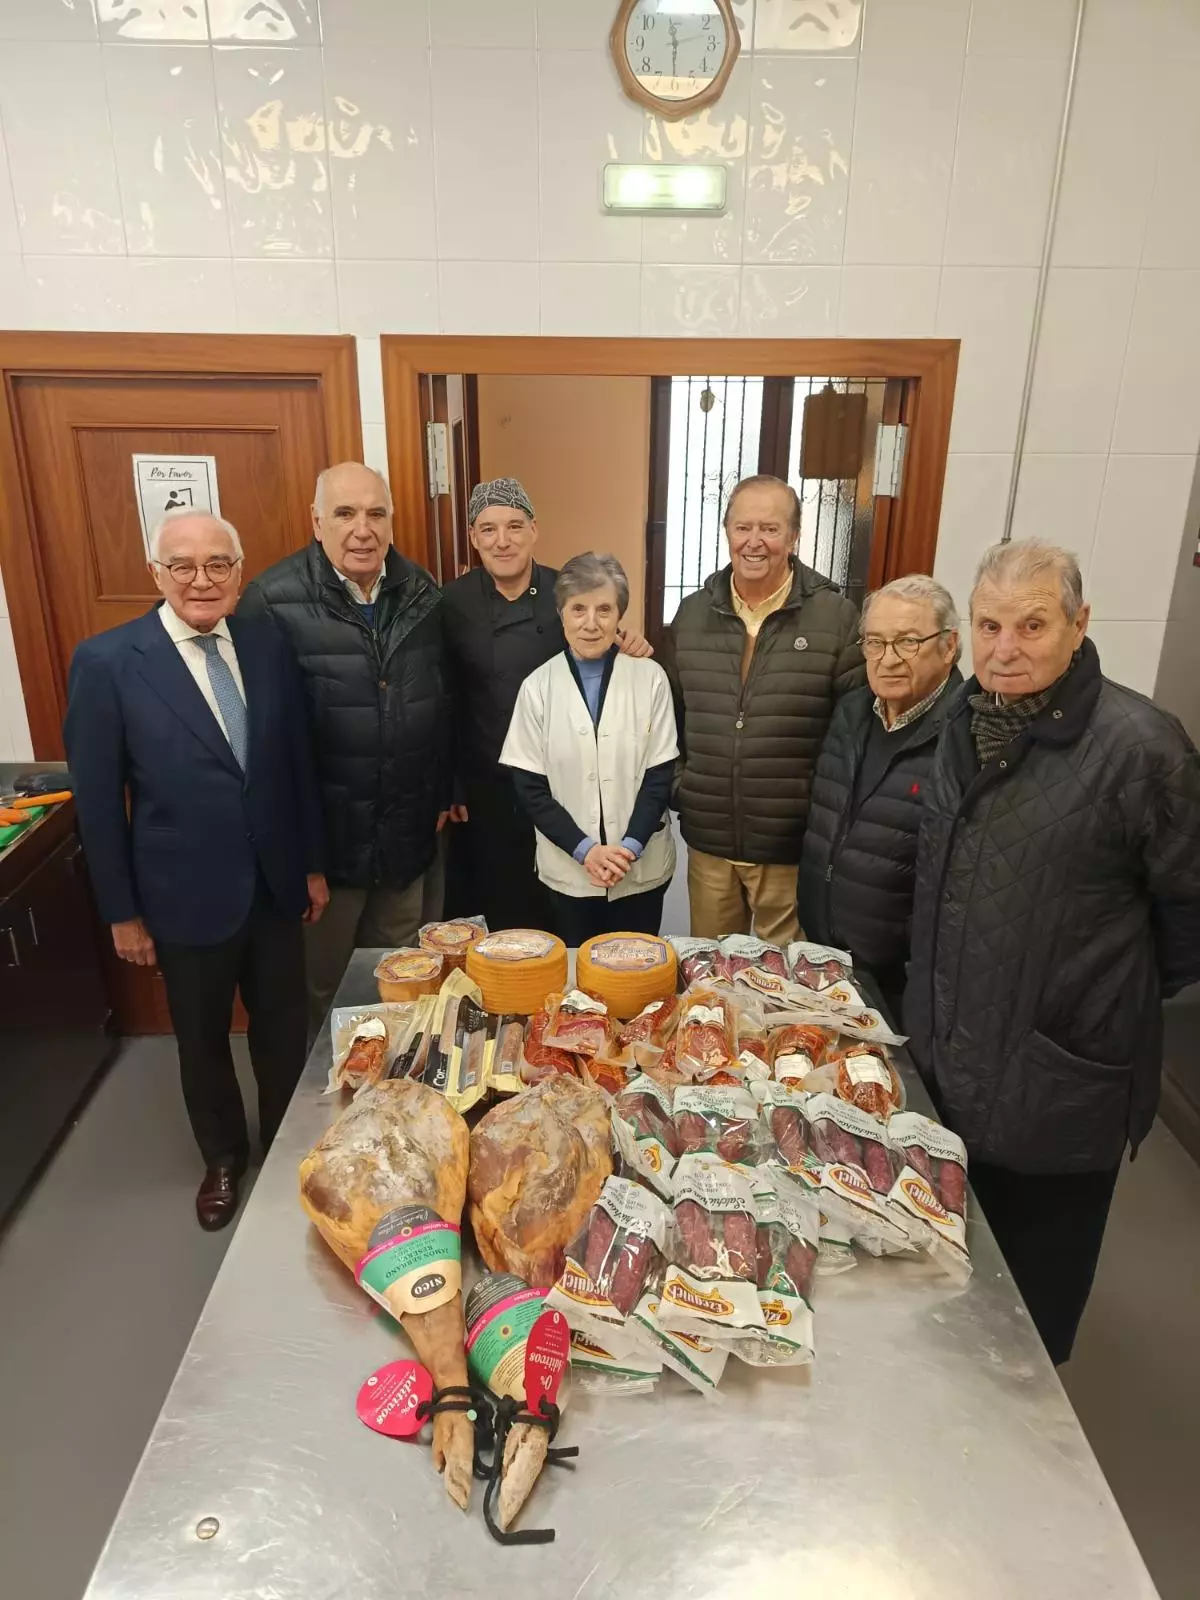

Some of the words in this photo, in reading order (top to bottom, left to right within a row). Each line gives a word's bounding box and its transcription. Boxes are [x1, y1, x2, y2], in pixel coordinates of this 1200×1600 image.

[643, 14, 655, 31] 10
[702, 14, 710, 30] 2
[636, 35, 645, 51] 9
[707, 35, 717, 51] 3
[642, 56, 651, 72] 8
[699, 57, 707, 72] 4
[150, 466, 166, 478] Por
[168, 467, 193, 479] Favor
[397, 1245, 433, 1262] RESERVA
[385, 1255, 422, 1278] SERRANO
[414, 1276, 443, 1296] NICO
[667, 1283, 723, 1315] Ezequiel
[540, 1375, 553, 1390] 0%
[375, 1367, 417, 1425] Aditivos
[400, 1393, 419, 1415] 0%
